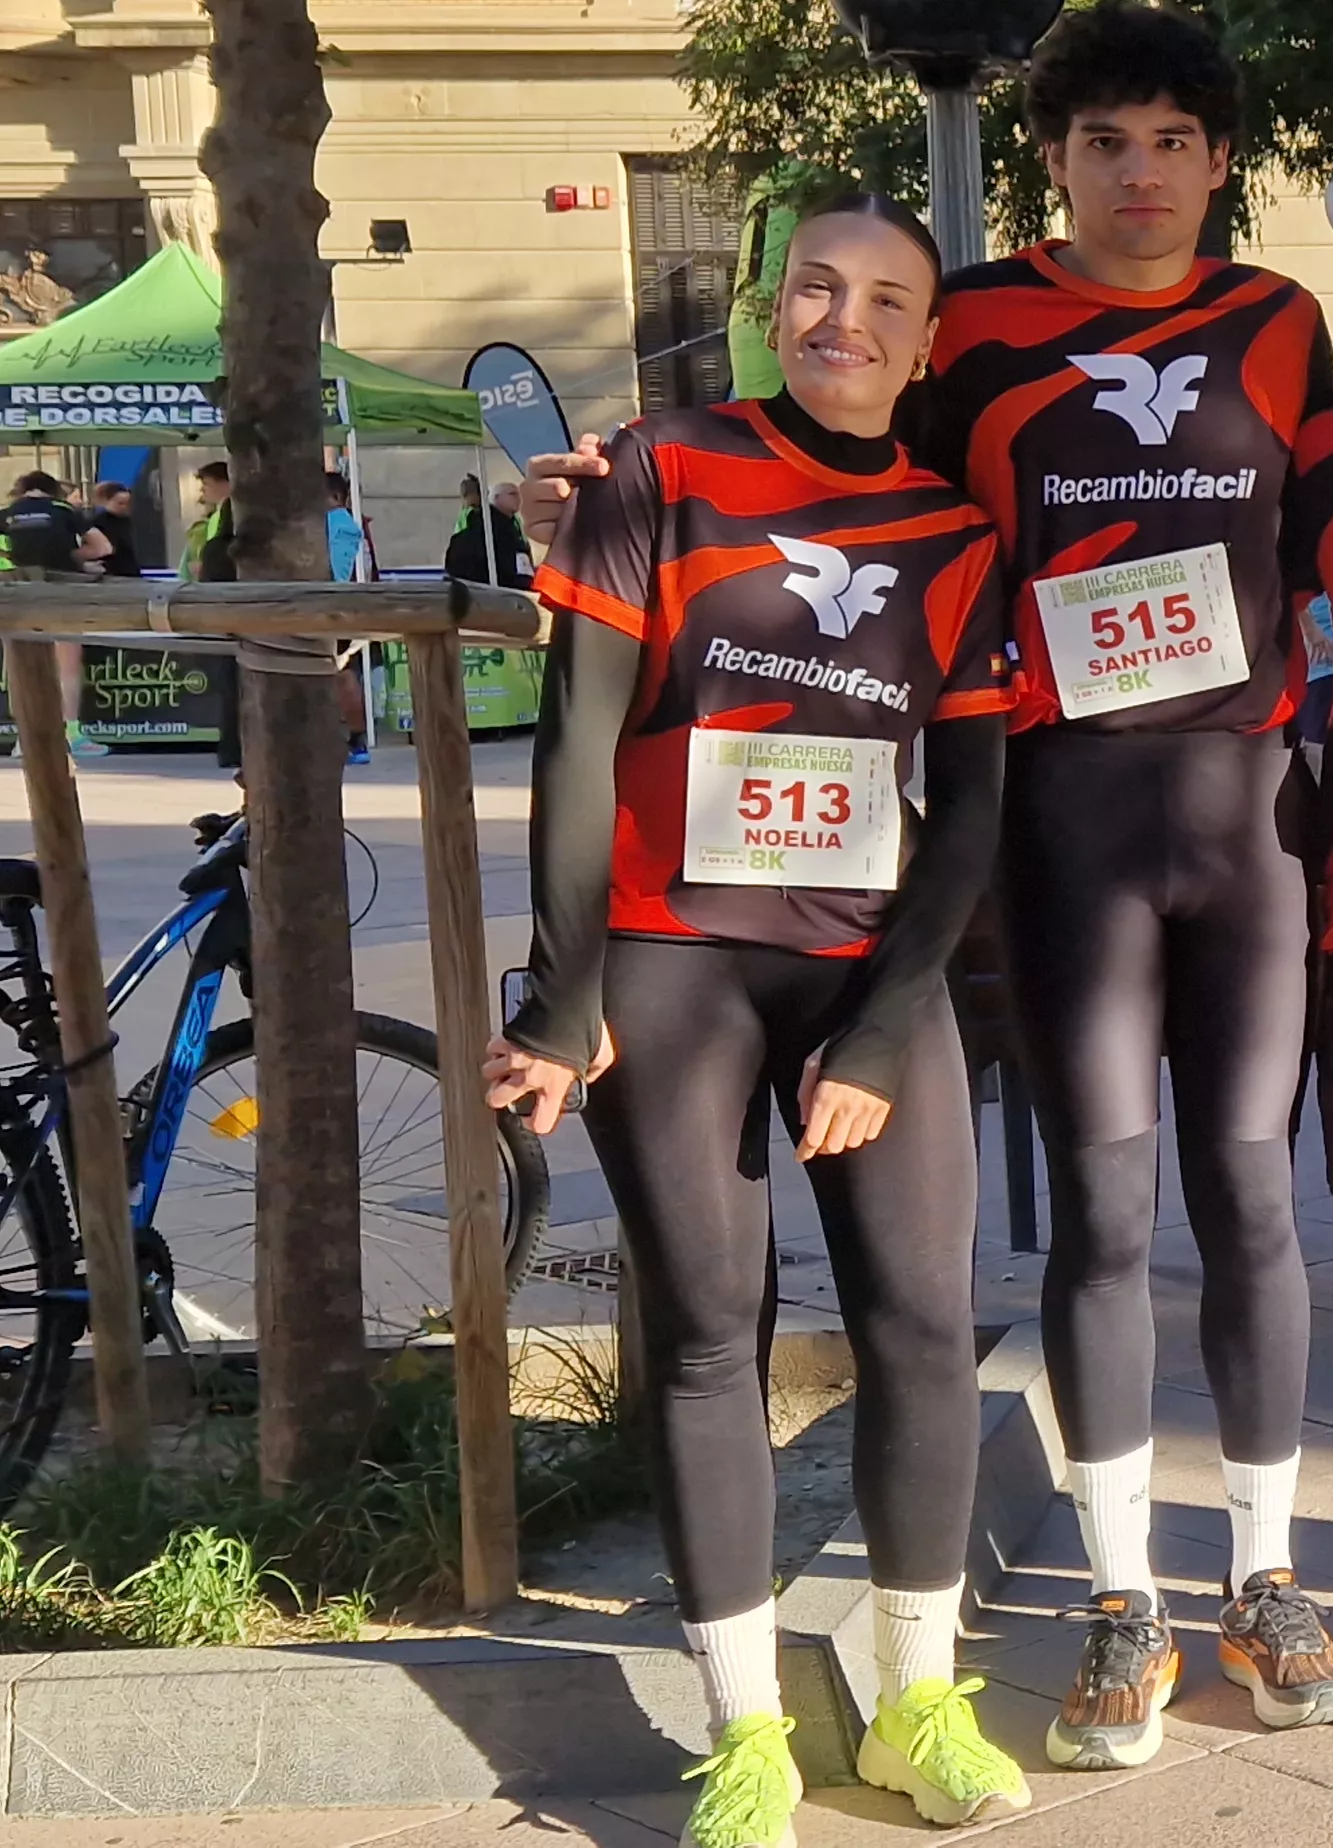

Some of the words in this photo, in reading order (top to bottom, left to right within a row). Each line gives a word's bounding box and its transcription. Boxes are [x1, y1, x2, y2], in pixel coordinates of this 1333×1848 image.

[11, 384, 206, 404] RECOGIDA
[0, 407, 27, 426] E
[1043, 468, 1258, 506] Recambiofacil
[1085, 575, 1100, 588] III
[1102, 559, 1185, 585] CARRERA
[1088, 580, 1145, 601] EMPRESAS
[1147, 571, 1187, 589] HUESCA
[1091, 593, 1196, 650] 515
[88, 649, 180, 682] rtleck
[1088, 636, 1213, 677] SANTIAGO
[1116, 669, 1154, 693] 8K
[95, 682, 181, 719] Sport
[81, 720, 188, 738] ecksport.com
[748, 742, 763, 755] III
[768, 742, 855, 760] CARRERA
[747, 756, 807, 770] EMPRESAS
[810, 758, 854, 773] HUESCA
[737, 778, 851, 825] 513
[744, 828, 843, 849] NOELIA
[749, 850, 787, 871] 8K
